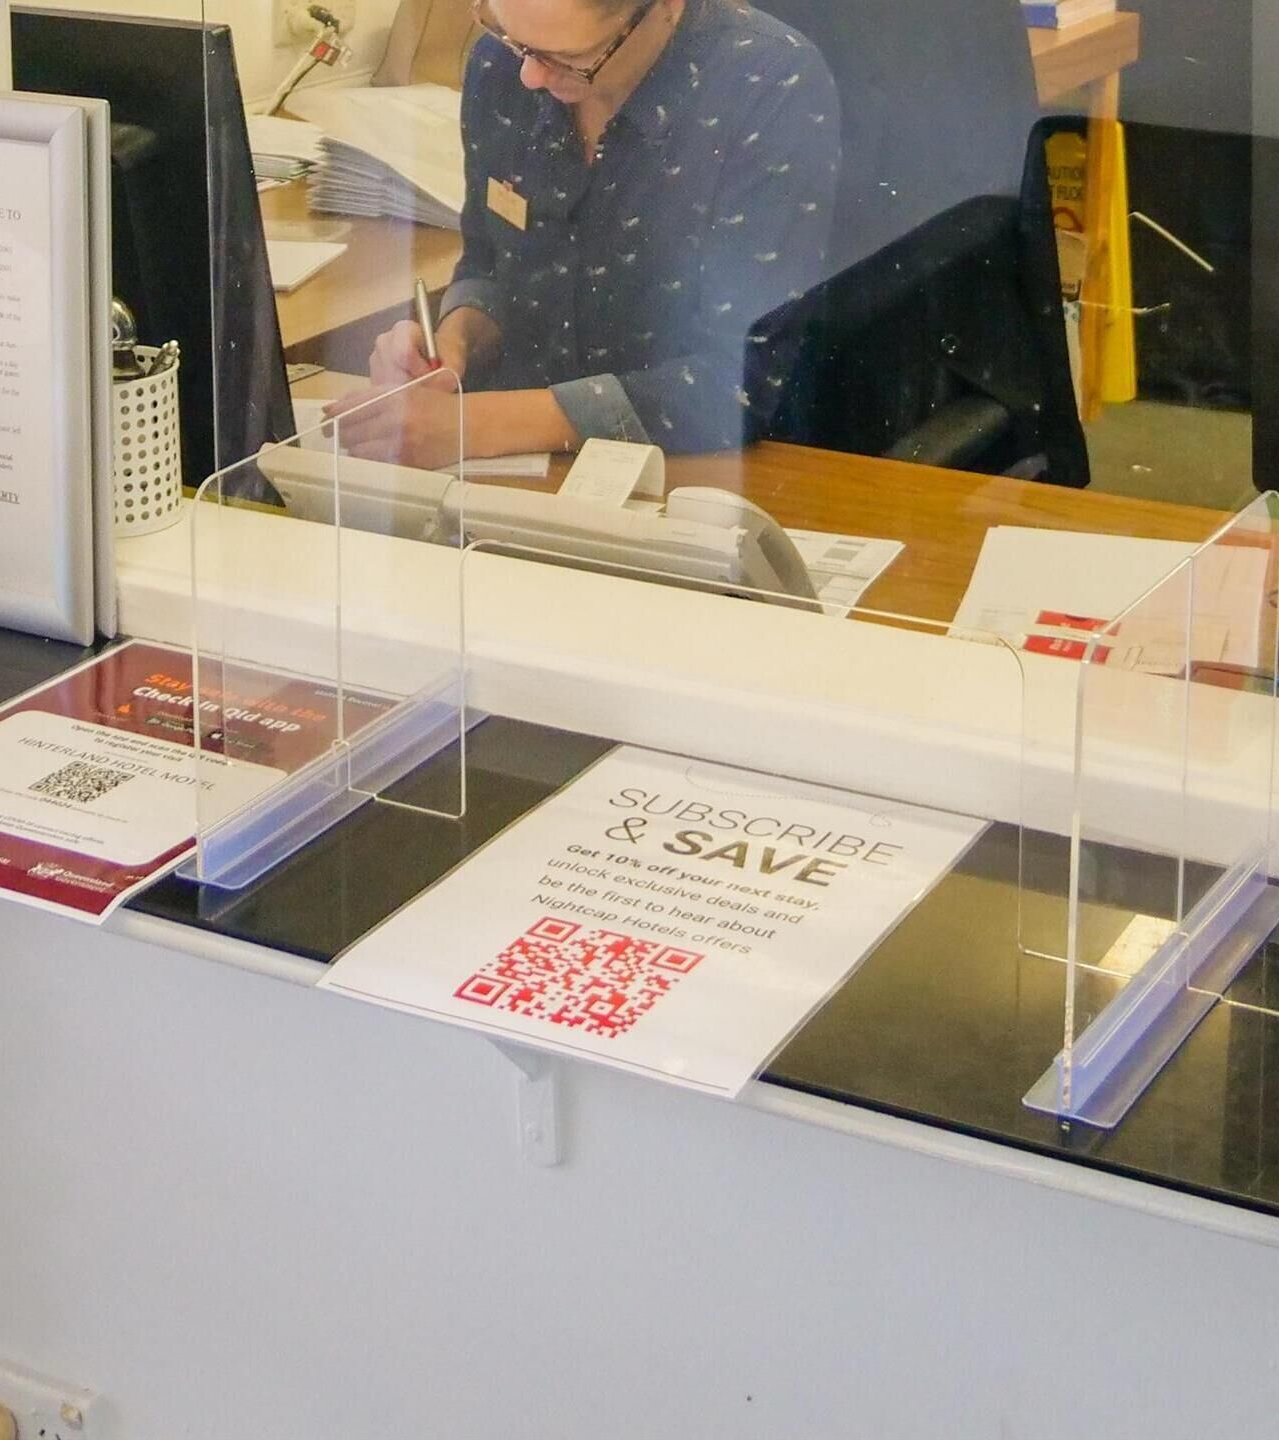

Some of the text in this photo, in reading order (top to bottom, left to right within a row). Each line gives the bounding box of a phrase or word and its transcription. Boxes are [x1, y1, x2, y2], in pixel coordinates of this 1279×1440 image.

[6, 210, 22, 221] TO
[133, 686, 193, 708] Check
[225, 706, 259, 723] Qld
[260, 717, 302, 734] app
[18, 737, 218, 791] HINTERLAND HOTEL MOTEL
[605, 817, 848, 888] & SAVE
[608, 787, 906, 867] SUBSCRIBE
[538, 876, 778, 939] be the first to hear about
[547, 859, 805, 925] unlock exclusive deals and
[566, 844, 820, 911] Get 10% off your next stay,
[531, 894, 753, 955] Nightcap Hotels offers
